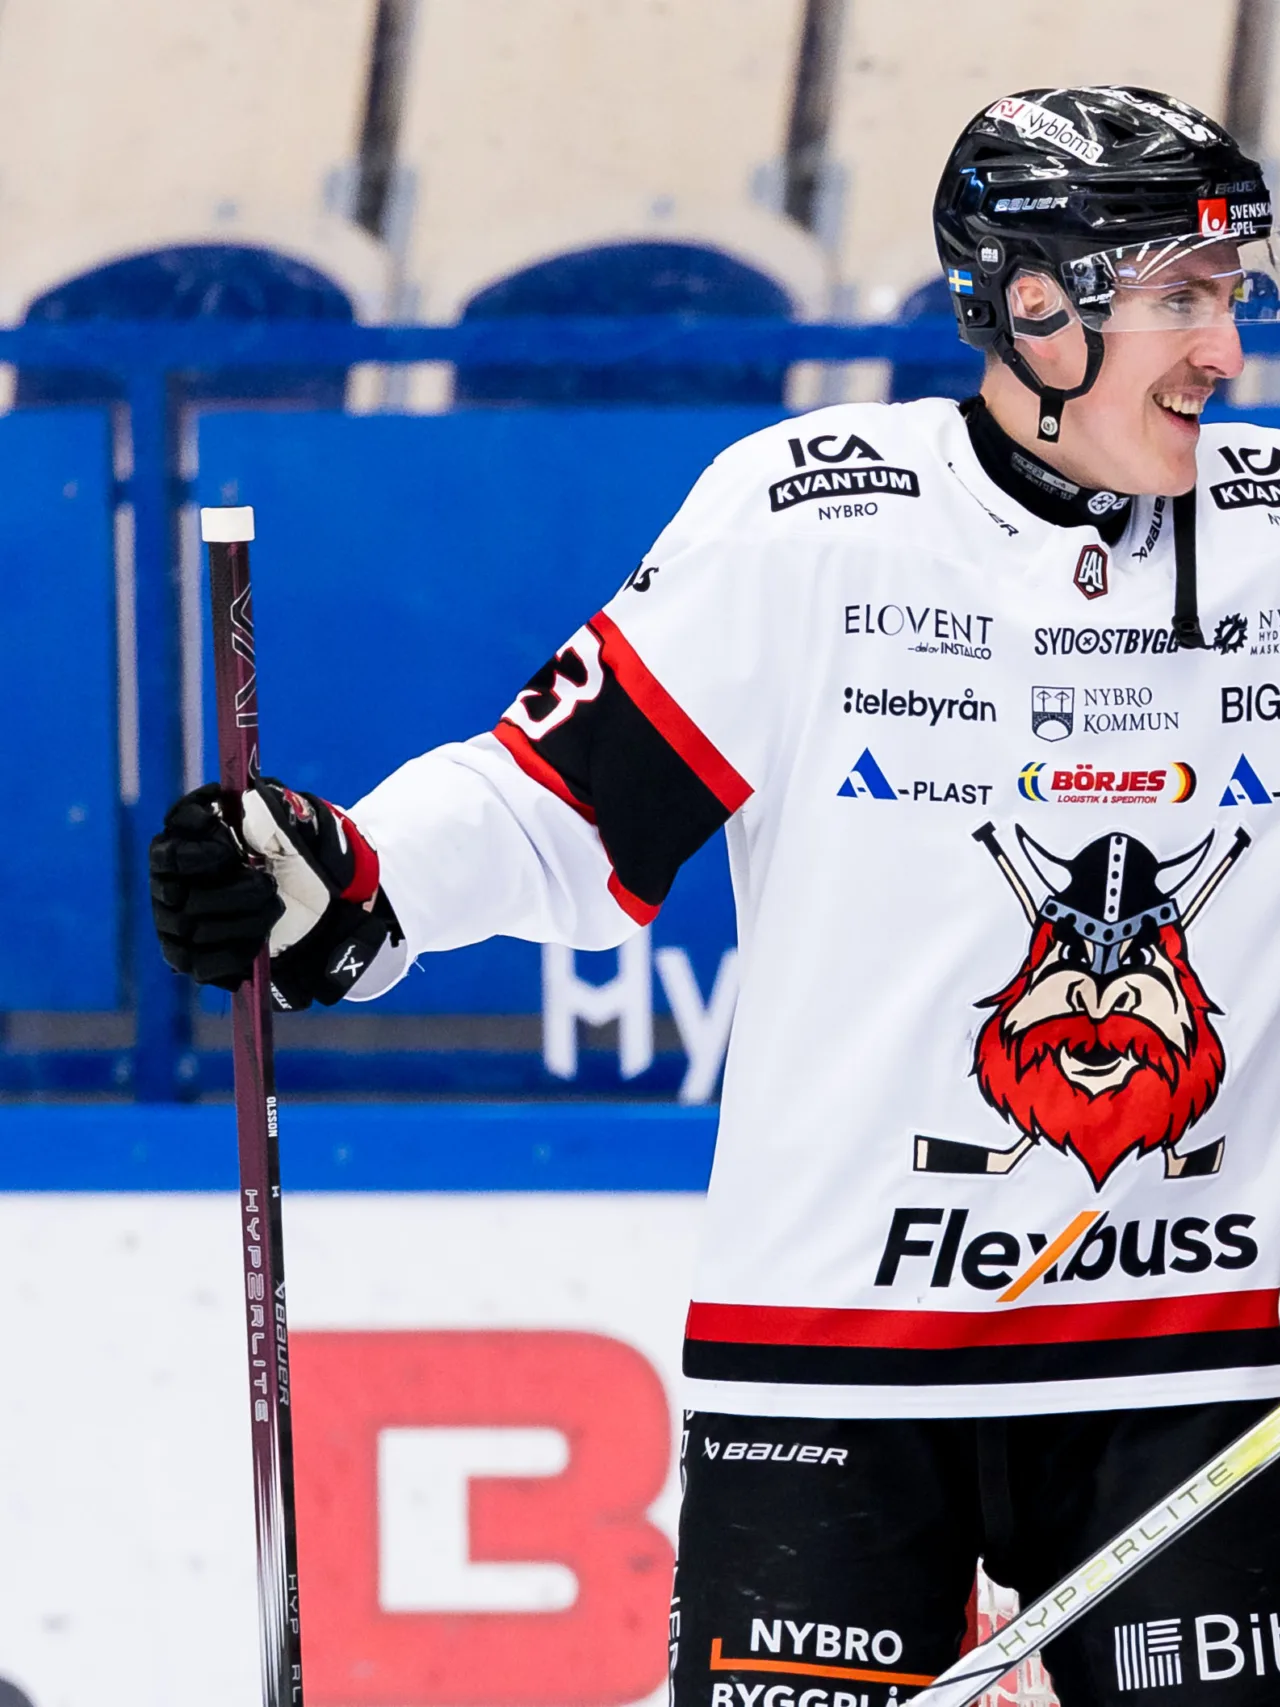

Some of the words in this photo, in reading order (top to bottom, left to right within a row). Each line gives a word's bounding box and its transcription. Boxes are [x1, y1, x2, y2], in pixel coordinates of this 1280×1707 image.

[1024, 107, 1099, 160] Nybloms
[994, 196, 1069, 212] BAUER
[1231, 220, 1257, 236] SPEL
[787, 433, 886, 468] ICA
[775, 470, 913, 505] KVANTUM
[817, 502, 879, 521] NYBRO
[844, 603, 994, 645] ELOVENT
[940, 641, 992, 661] INSTALCO
[1083, 687, 1153, 708] NYBRO
[1083, 712, 1180, 735] KOMMUN
[1050, 764, 1167, 793] BÖRJES
[1057, 794, 1099, 804] LOGISTIK
[1110, 795, 1157, 805] SPEDITION
[266, 1096, 278, 1138] OLSSON
[874, 1208, 1259, 1303] Flexbuss
[275, 1303, 290, 1406] BAUER
[722, 1442, 849, 1466] BAUER
[750, 1618, 903, 1665] NYBRO
